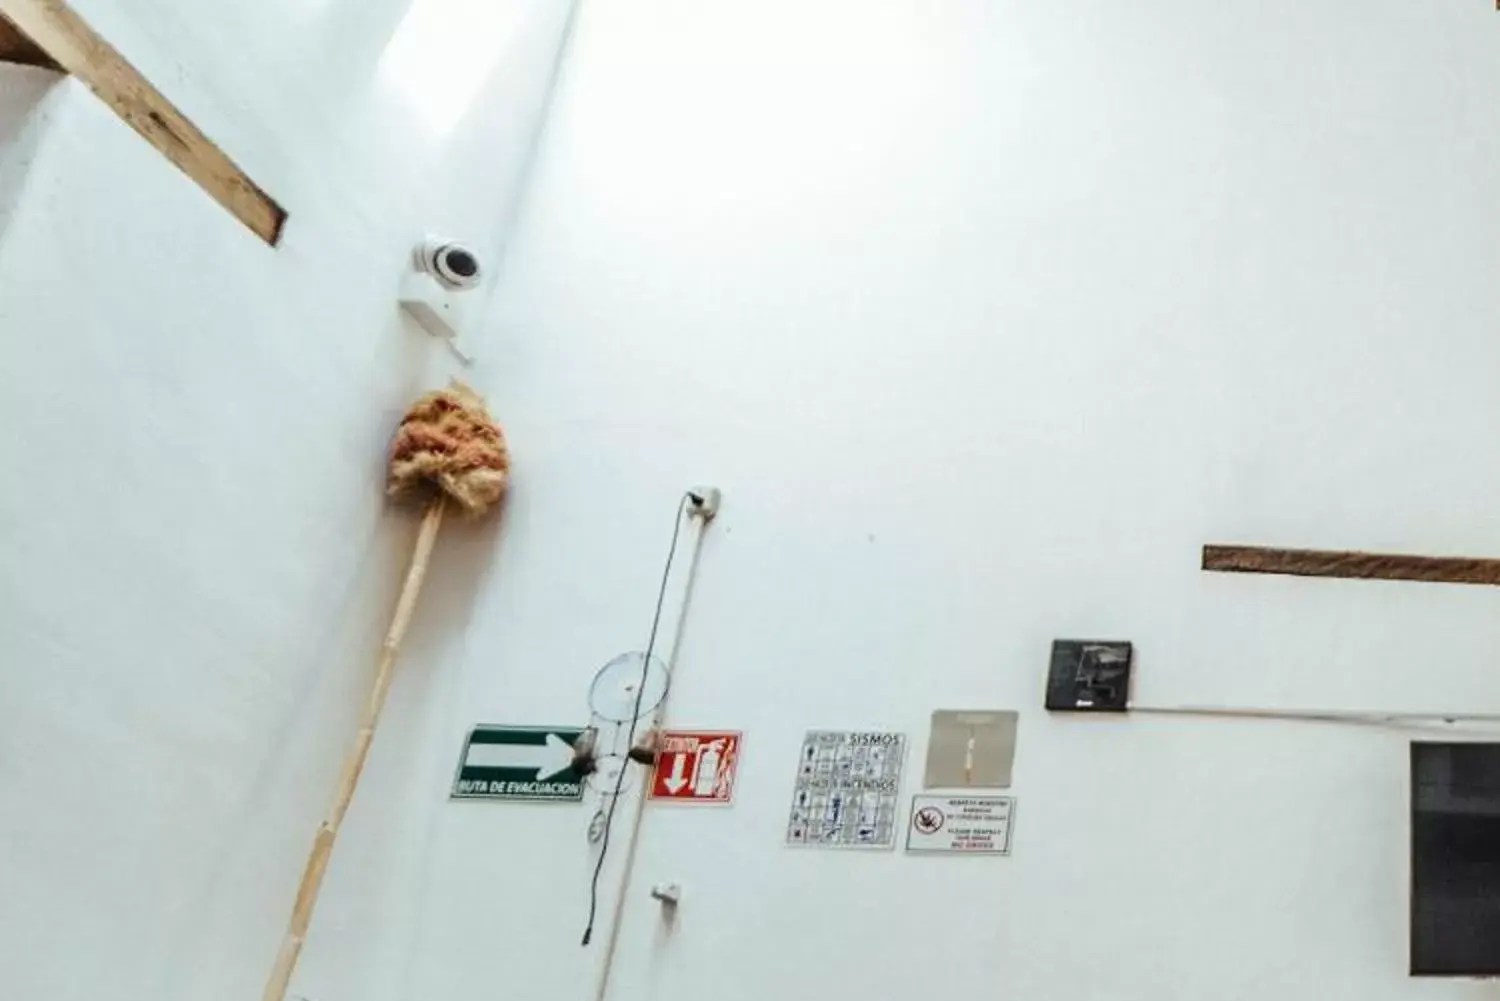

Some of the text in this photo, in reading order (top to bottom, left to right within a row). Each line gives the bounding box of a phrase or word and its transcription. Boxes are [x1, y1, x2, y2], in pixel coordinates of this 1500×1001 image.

[849, 733, 899, 746] SISMOS
[459, 779, 578, 794] RUTA DE EVACUACION
